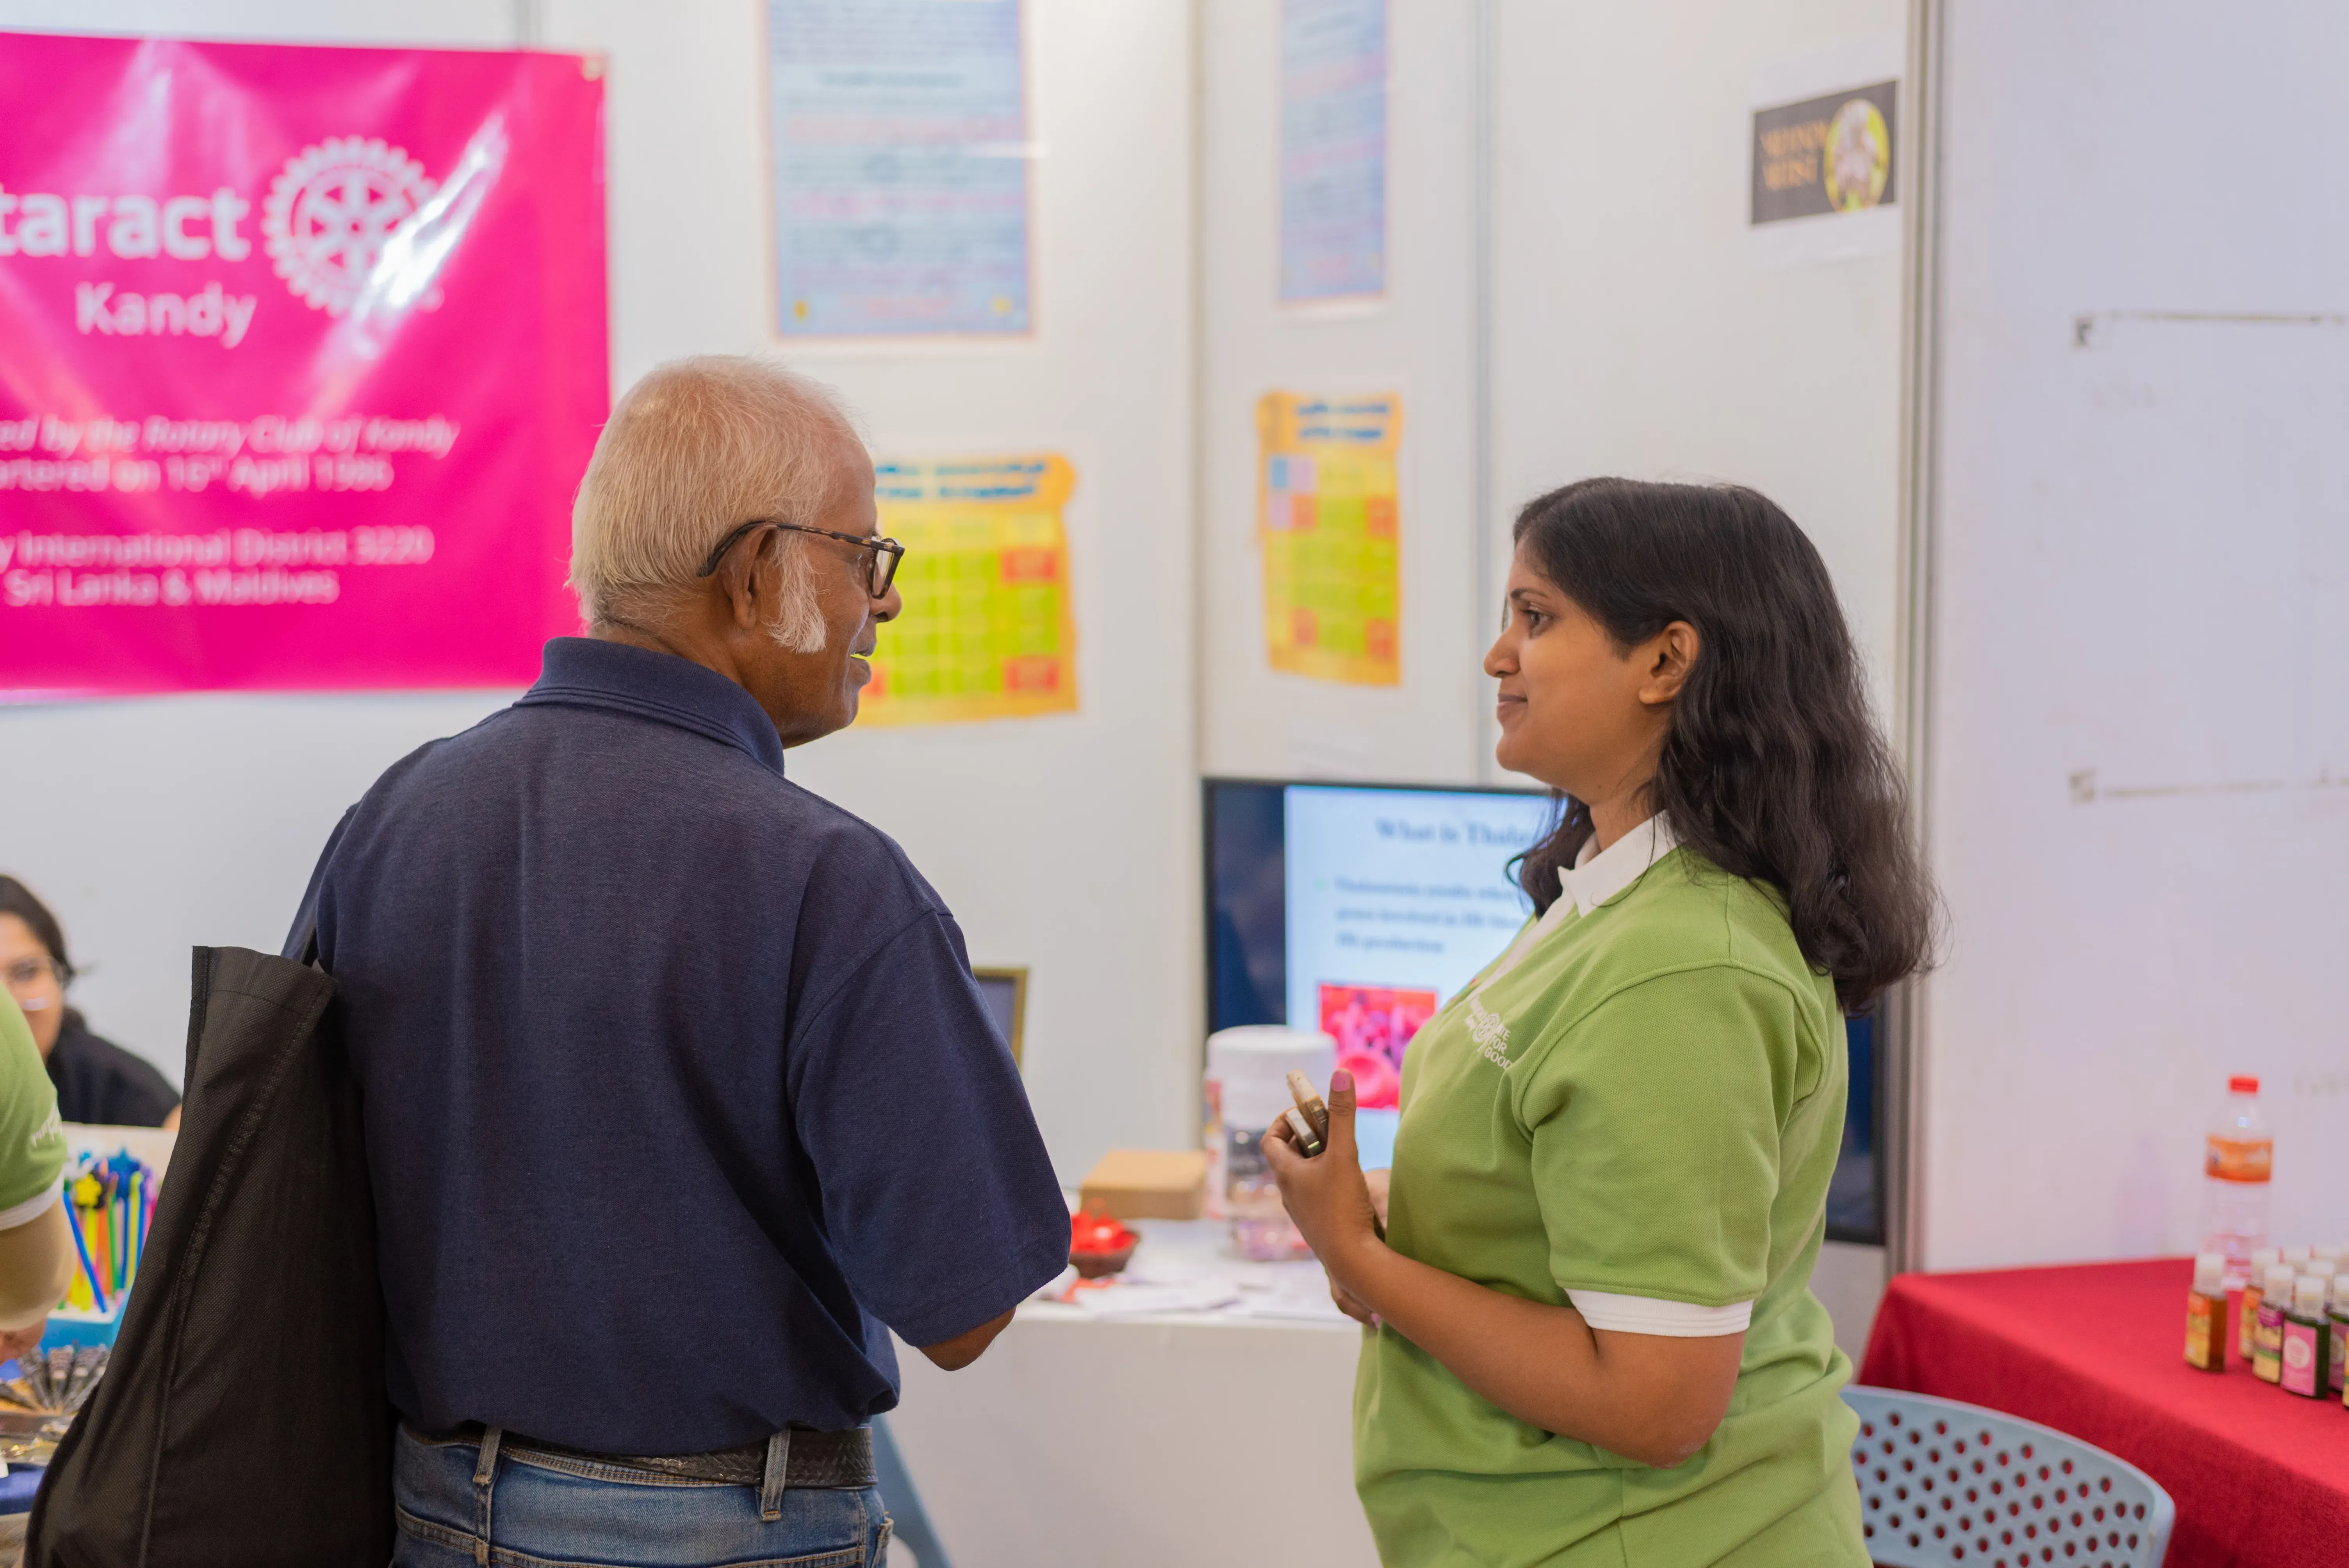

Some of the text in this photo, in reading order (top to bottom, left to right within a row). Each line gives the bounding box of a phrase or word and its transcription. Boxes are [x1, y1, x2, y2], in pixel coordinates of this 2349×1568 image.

[78, 283, 255, 347] Kandy
[41, 415, 81, 457] by
[85, 415, 139, 449] the
[144, 416, 247, 457] Rotary
[251, 415, 323, 451] Club
[327, 416, 365, 455] of
[362, 415, 459, 458] Kandy
[114, 460, 160, 490] on
[228, 454, 309, 497] April
[18, 529, 229, 564] International
[233, 529, 349, 564] District
[351, 527, 433, 562] 3220
[5, 567, 339, 604] Sri Lanka & Maldives
[1375, 818, 1435, 843] What
[1439, 821, 1461, 844] is
[1484, 1046, 1513, 1071] GOOD
[1488, 1034, 1507, 1055] FOR
